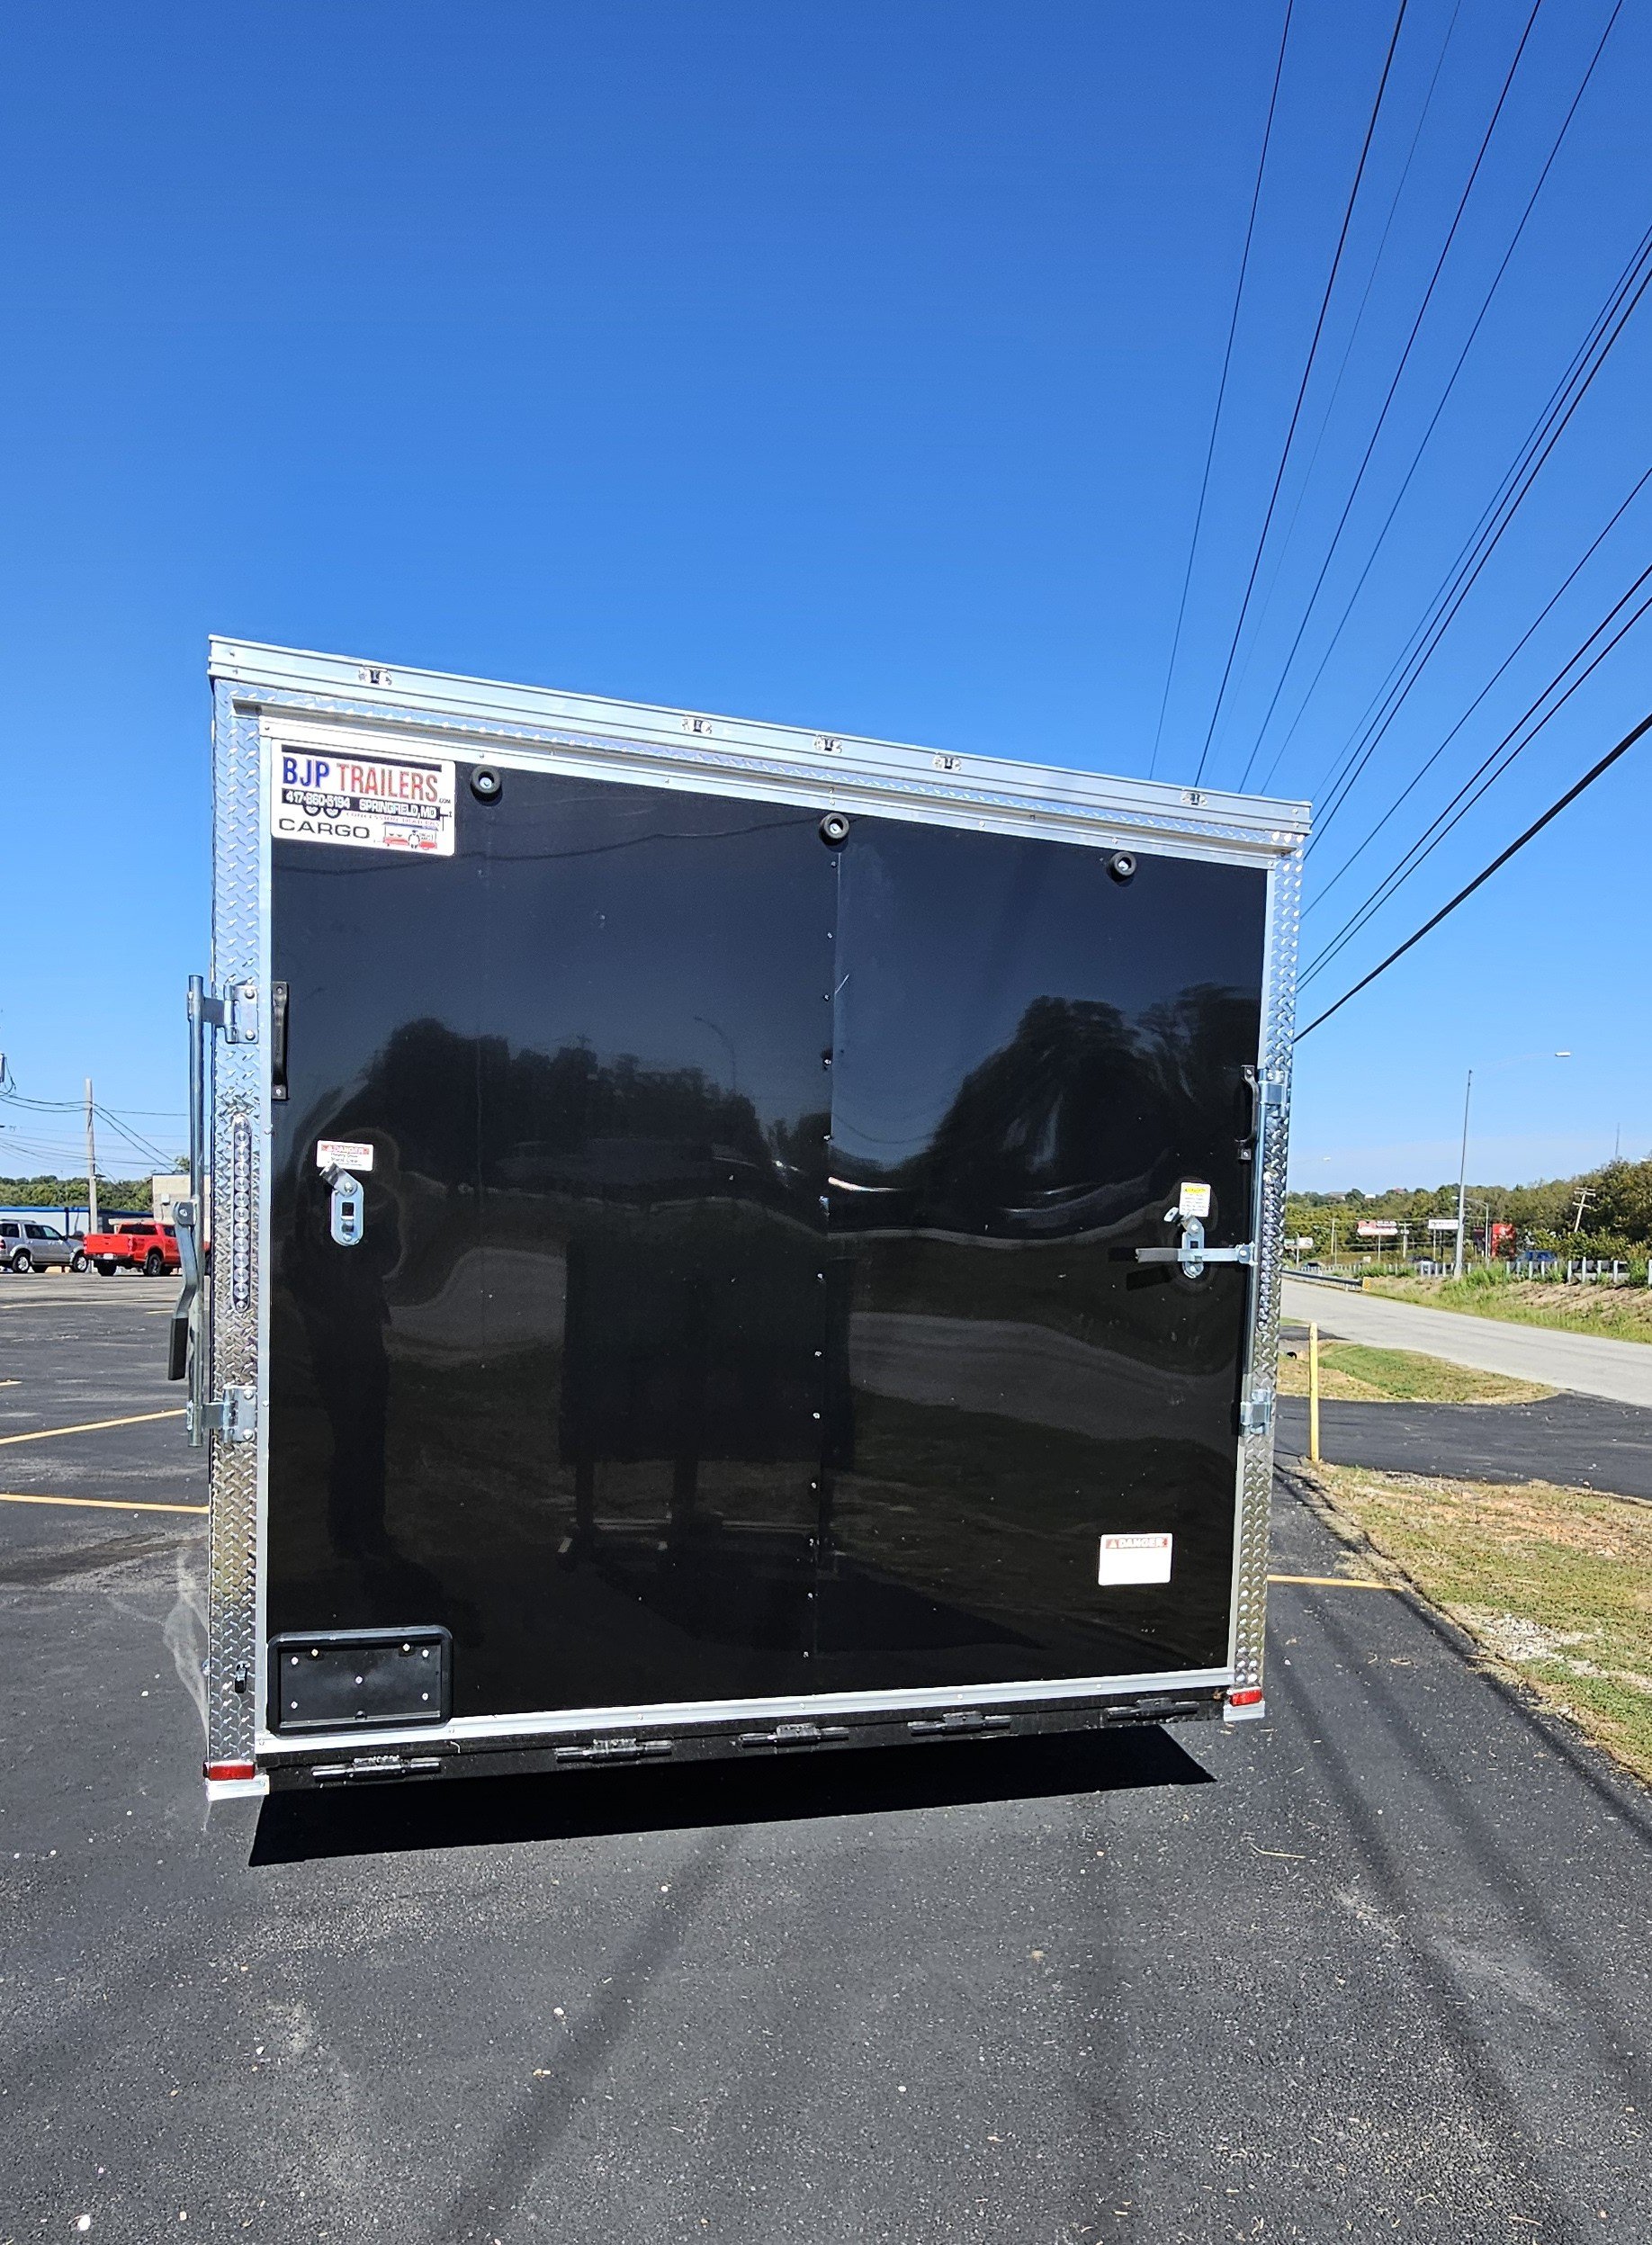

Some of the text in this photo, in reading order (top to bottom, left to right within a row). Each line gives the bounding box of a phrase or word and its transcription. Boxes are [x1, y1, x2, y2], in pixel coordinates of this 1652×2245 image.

[282, 756, 439, 803] BJP TRAILERS
[278, 818, 370, 840] CARGO
[1118, 1537, 1163, 1548] DANGER
